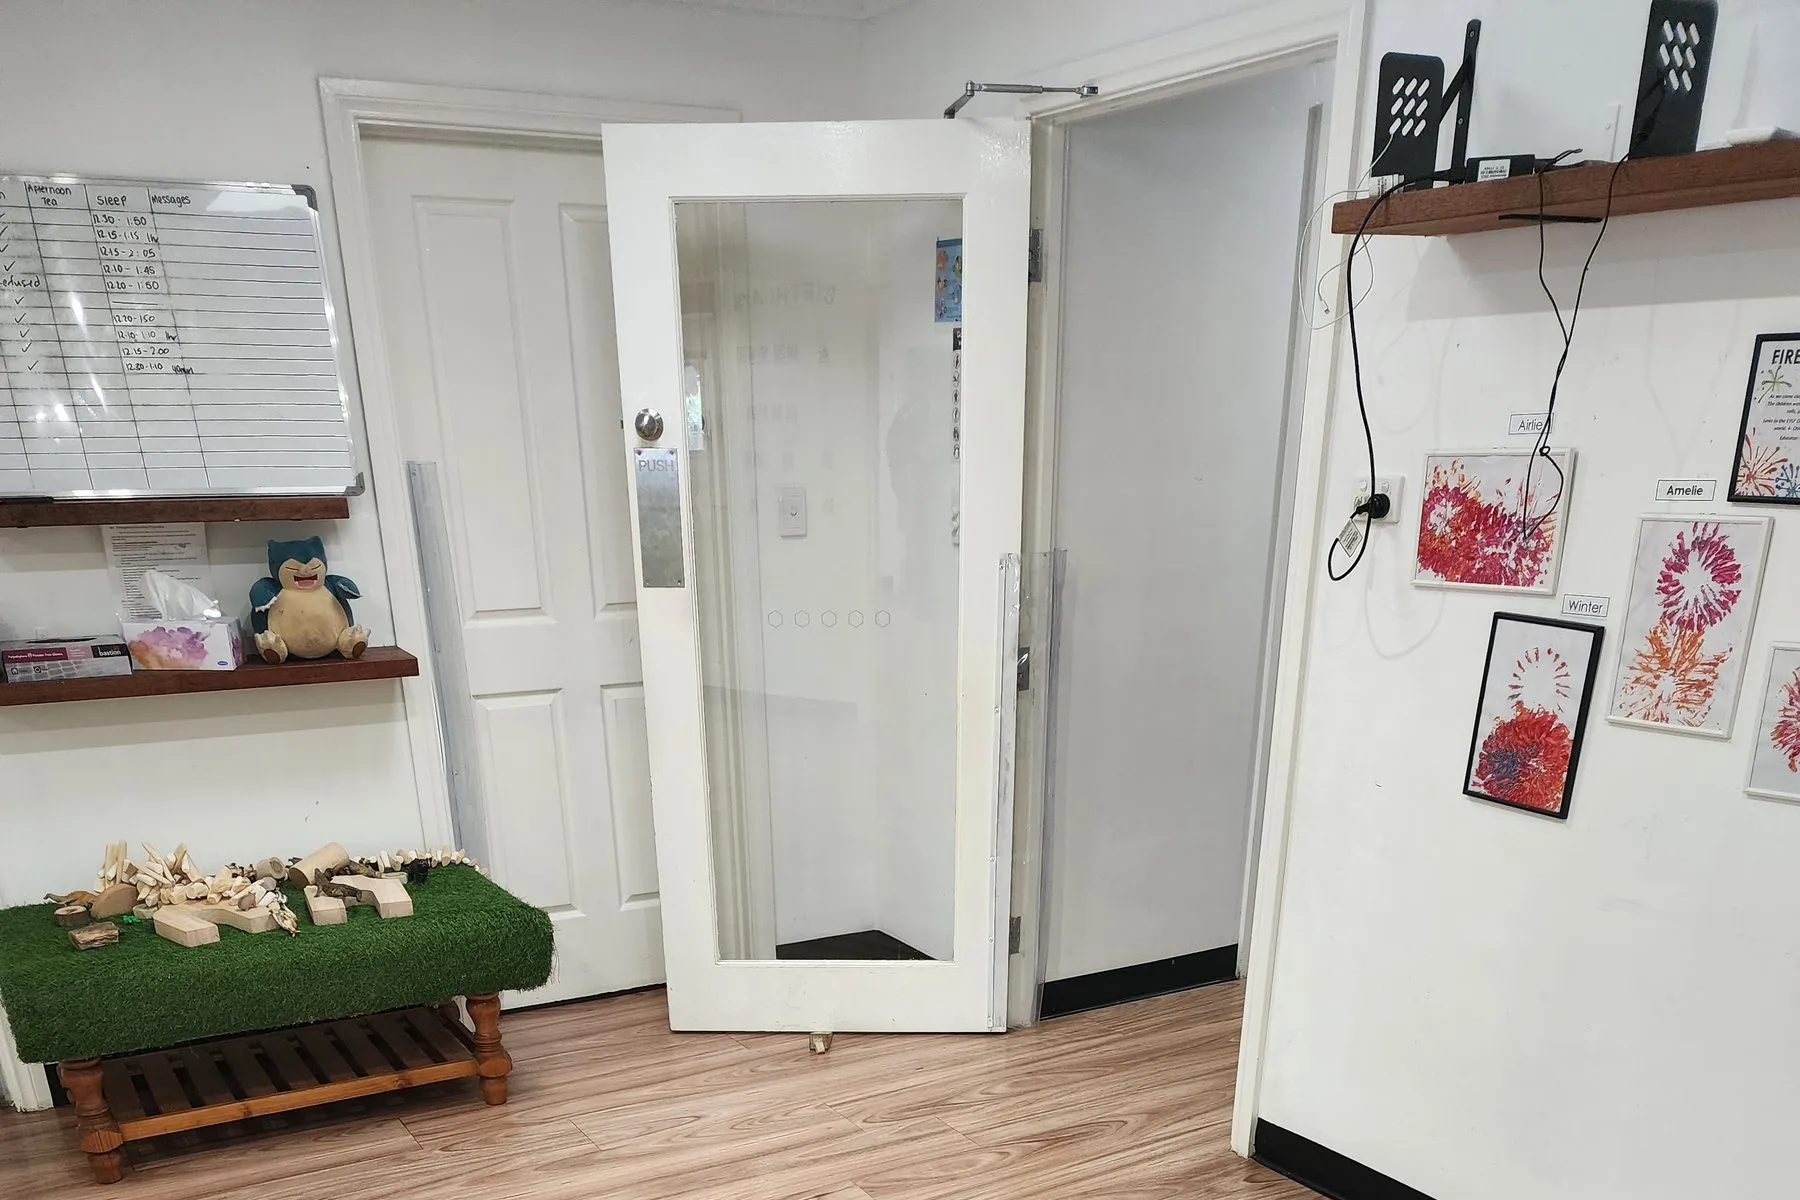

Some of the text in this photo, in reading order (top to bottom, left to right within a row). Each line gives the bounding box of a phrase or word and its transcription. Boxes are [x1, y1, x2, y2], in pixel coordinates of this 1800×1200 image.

[28, 183, 72, 196] Afternoon
[41, 197, 58, 206] Tea
[96, 195, 127, 207] Sleep
[151, 194, 191, 208] Messages
[0, 275, 41, 288] efused
[1518, 419, 1543, 431] Airlie
[638, 459, 674, 472] PUSH
[1666, 485, 1704, 497] Amelie
[1568, 599, 1603, 614] Winter
[98, 645, 122, 657] bastion
